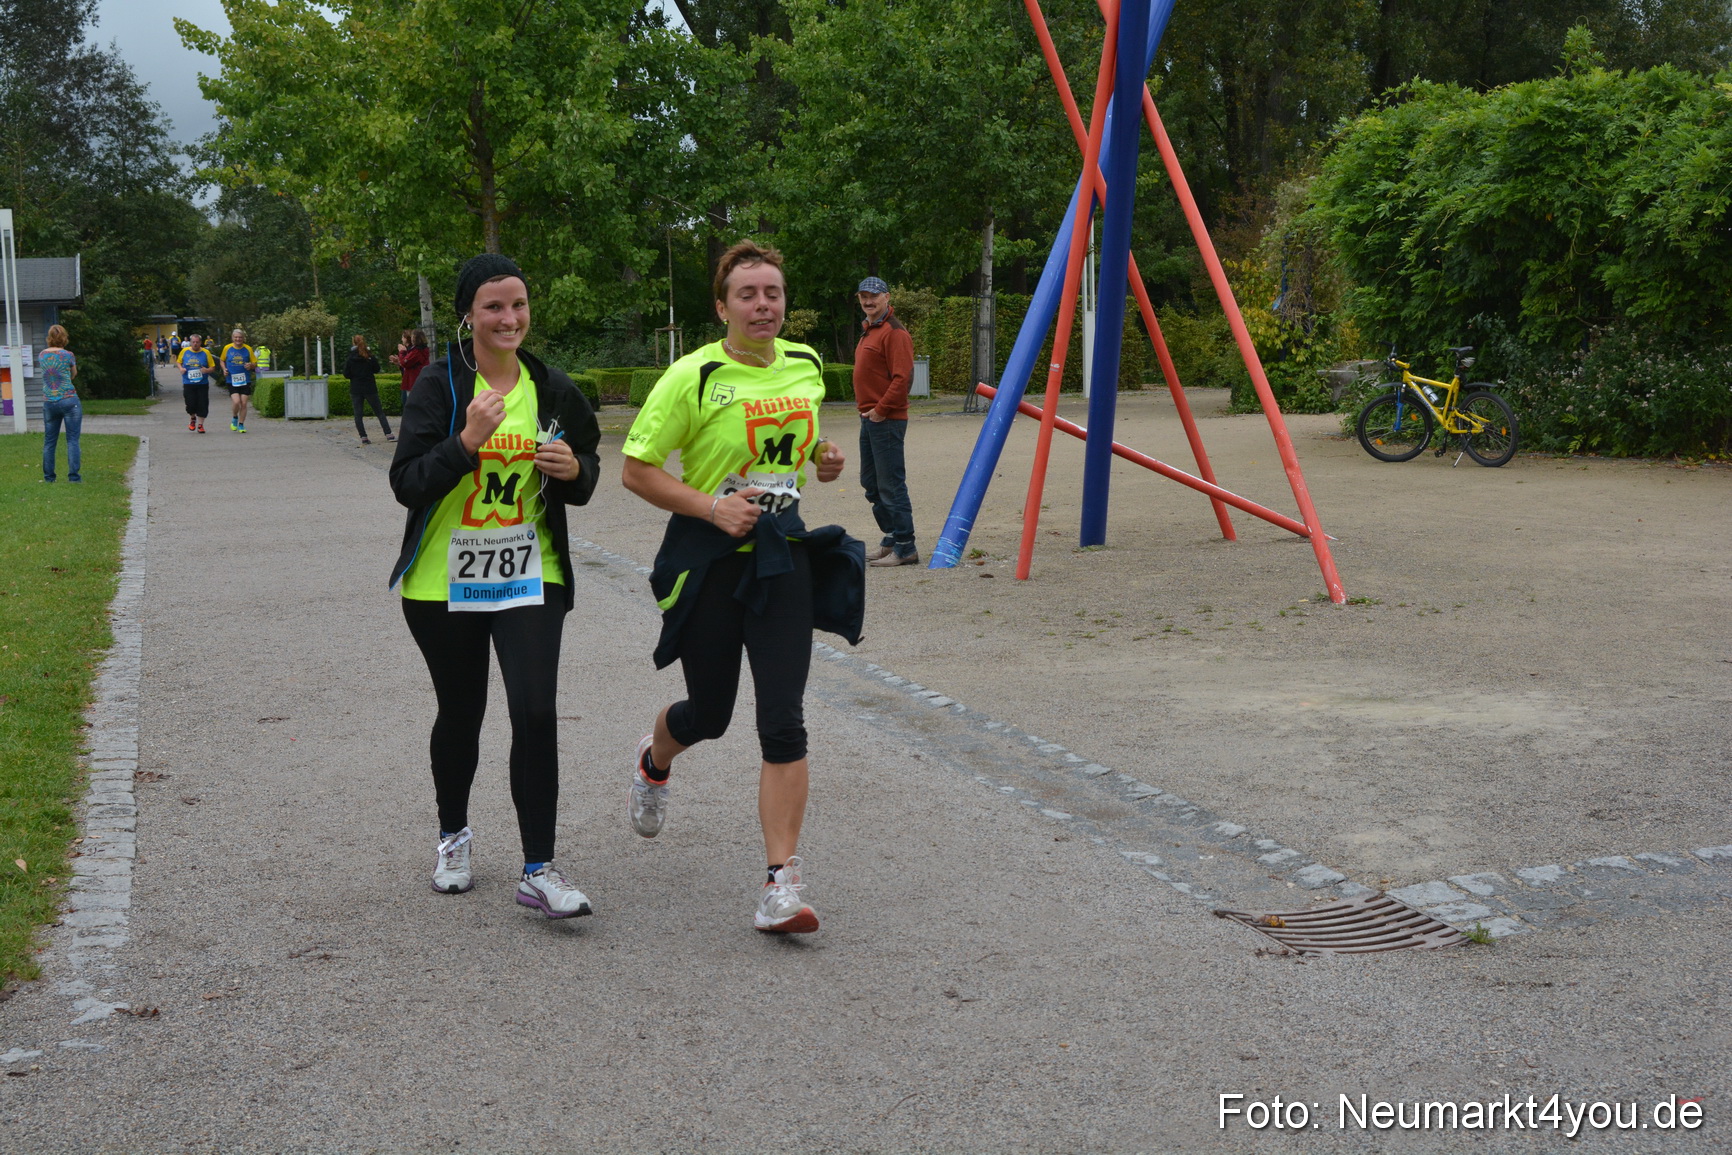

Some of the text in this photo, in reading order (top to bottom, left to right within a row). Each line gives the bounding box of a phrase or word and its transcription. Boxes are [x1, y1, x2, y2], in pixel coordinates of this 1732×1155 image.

[742, 396, 811, 419] Müller
[756, 433, 796, 466] M
[481, 472, 521, 506] M
[450, 534, 525, 546] PARTL Neumarkt
[458, 545, 533, 579] 2787
[463, 585, 528, 599] Dominique
